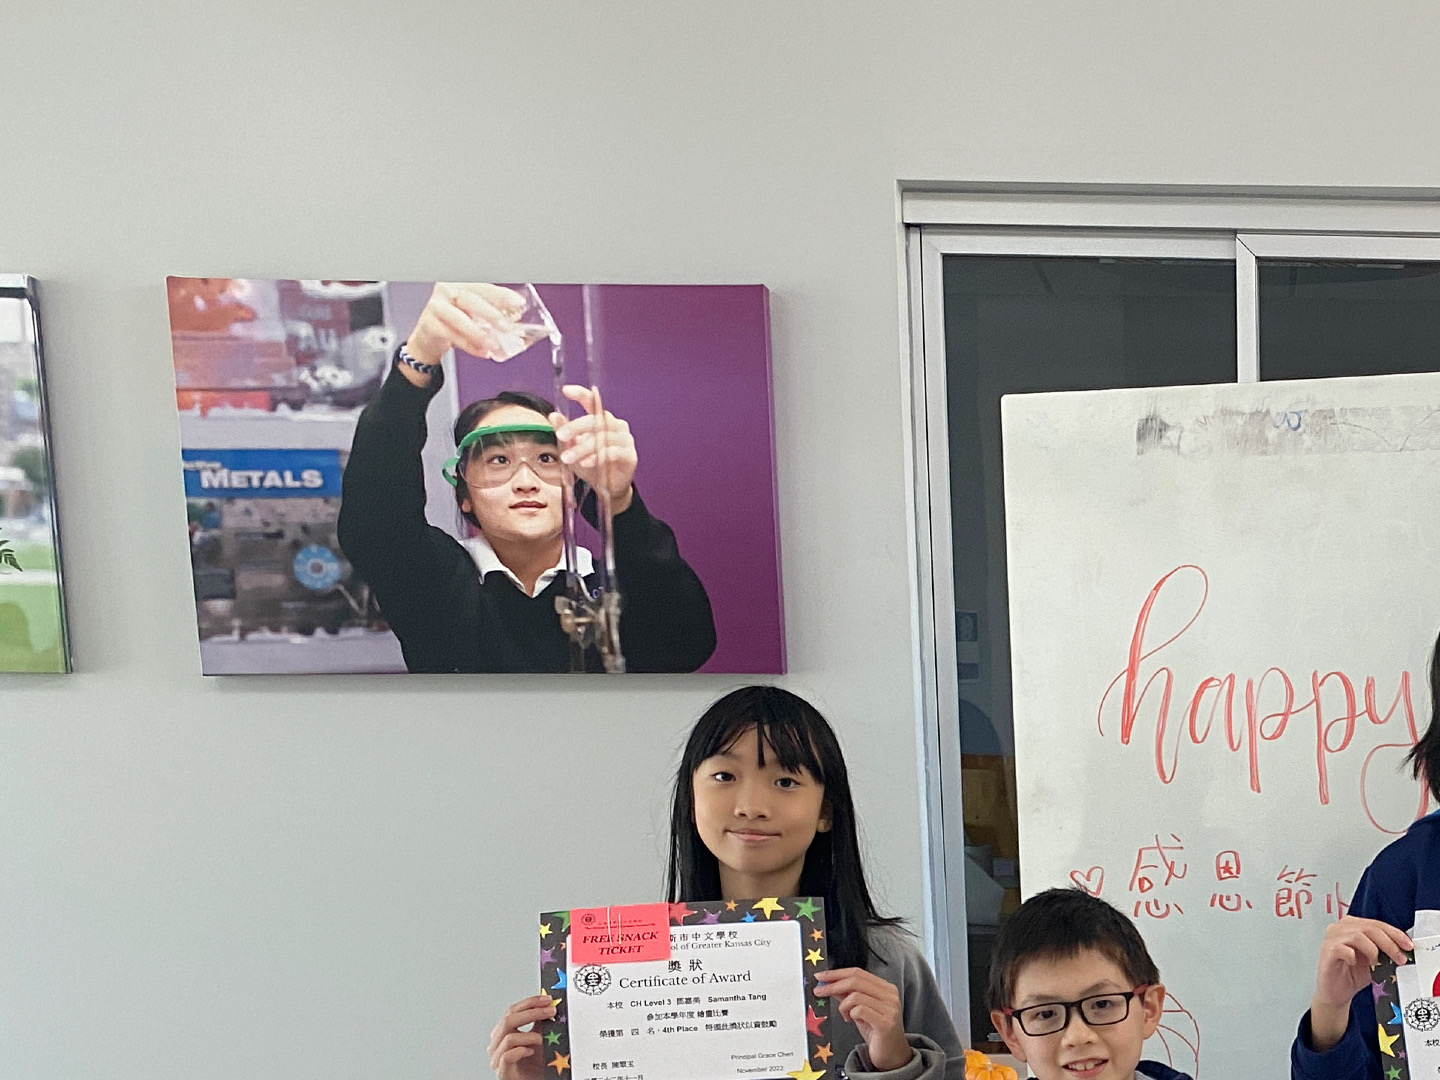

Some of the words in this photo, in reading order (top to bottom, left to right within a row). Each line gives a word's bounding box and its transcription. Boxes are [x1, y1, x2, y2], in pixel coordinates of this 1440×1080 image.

[200, 468, 323, 489] METALS
[1098, 564, 1429, 834] happy
[583, 934, 614, 944] FREE
[617, 931, 659, 942] SNACK
[599, 945, 644, 956] TICKET
[681, 942, 690, 950] of
[692, 941, 722, 949] Greater
[725, 940, 753, 948] Kansas
[754, 939, 772, 948] City
[620, 975, 688, 989] Certificate
[692, 973, 708, 984] of
[709, 970, 752, 984] Award
[644, 999, 665, 1007] Level
[707, 994, 746, 1003] Samantha
[748, 994, 767, 1002] Tang
[631, 1028, 640, 1036] 四
[662, 1026, 675, 1034] 4th
[677, 1025, 698, 1033] Place
[731, 1053, 756, 1061] Principal
